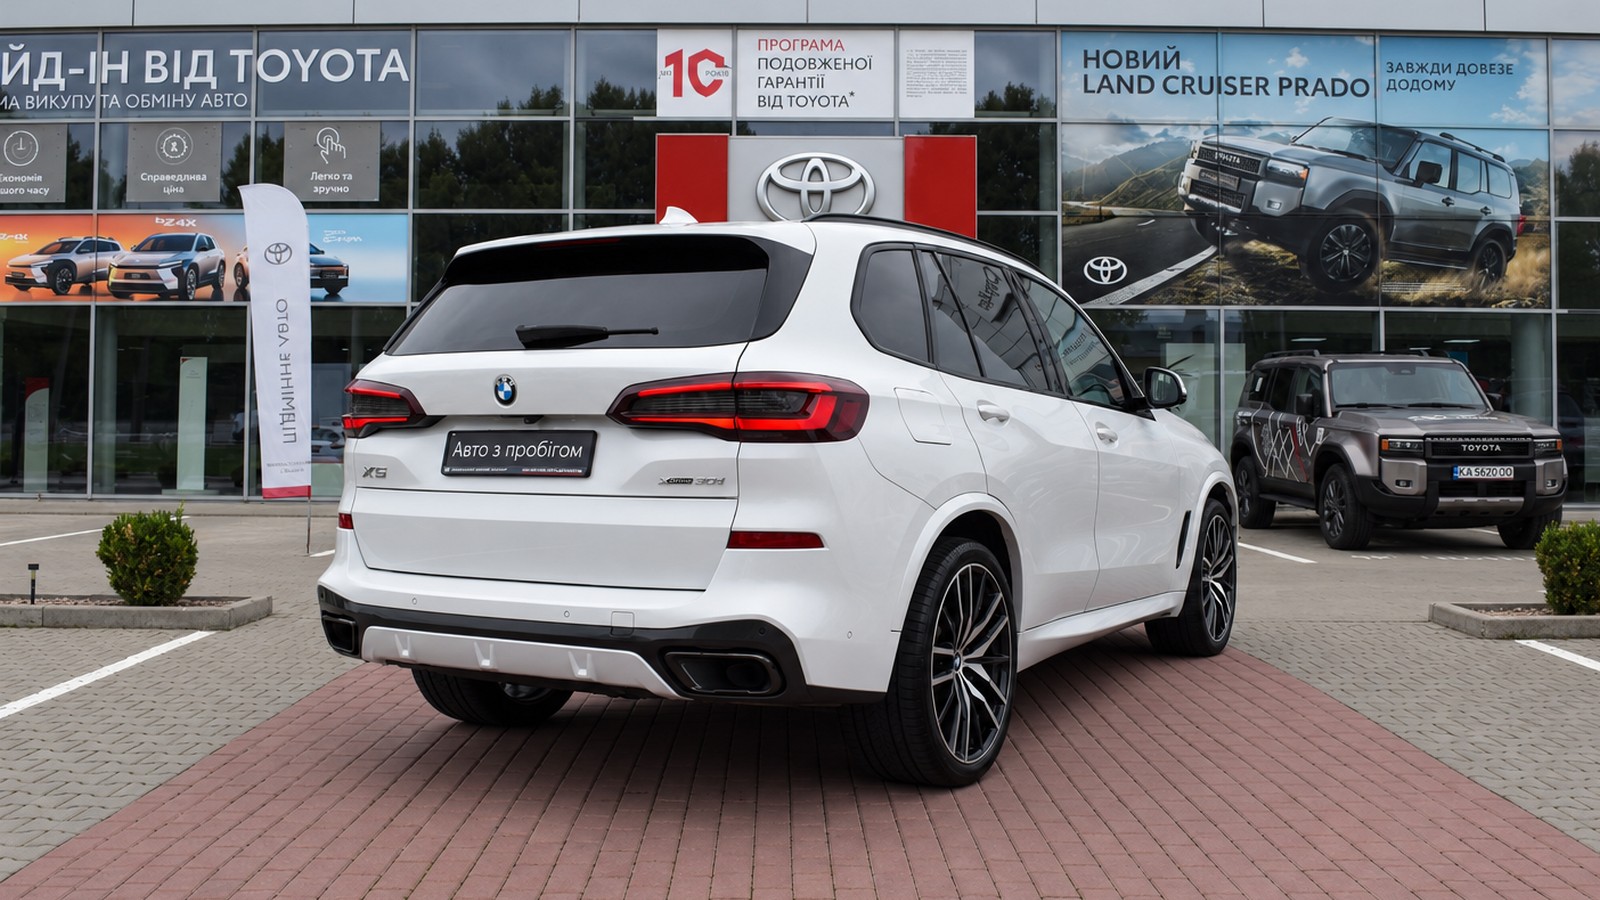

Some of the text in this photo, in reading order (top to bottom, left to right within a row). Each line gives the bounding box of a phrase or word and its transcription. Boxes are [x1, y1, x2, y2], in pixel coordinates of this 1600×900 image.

[757, 39, 845, 52] ПРОГРАМА
[757, 55, 873, 72] ПОДОВЖЕНОЇ
[1083, 45, 1181, 70] НОВИЙ
[145, 49, 217, 90] ВІД
[229, 48, 410, 83] TOYOTA
[1386, 62, 1514, 77] ЗАВЖДИ ДОВЕЗЕ
[757, 74, 825, 89] ГАРАНТІЇ
[1083, 74, 1370, 98] LAND CRUISER PRADO
[1386, 79, 1456, 92] ДОДОМУ
[25, 95, 96, 109] ВИКУПУ
[101, 94, 121, 109] ТА
[125, 93, 197, 109] ОБМІНУ
[201, 92, 248, 108] АВТО
[757, 95, 784, 110] ВІД
[452, 440, 583, 461] Авто з пробігом
[1461, 444, 1502, 452] TOYOTA
[362, 466, 388, 479] X5
